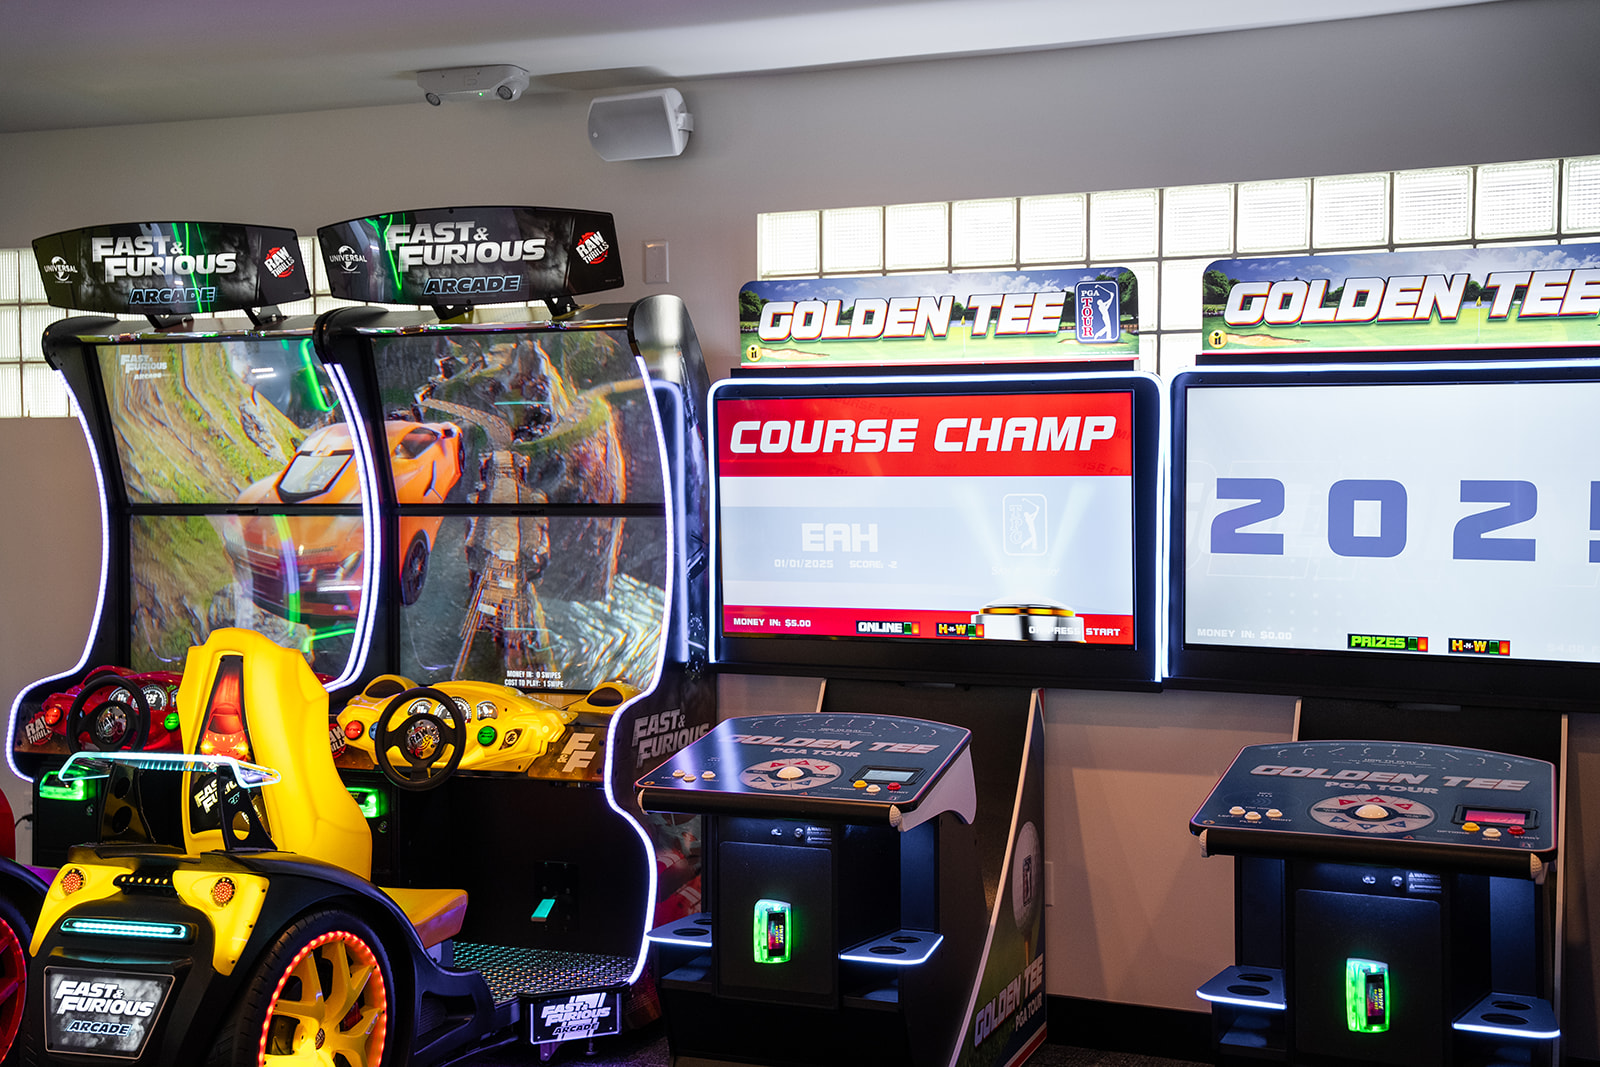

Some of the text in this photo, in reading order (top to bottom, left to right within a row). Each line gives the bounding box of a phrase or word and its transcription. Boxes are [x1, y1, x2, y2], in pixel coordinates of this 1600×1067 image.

[386, 221, 489, 250] FAST &
[576, 231, 604, 258] RAW
[92, 236, 184, 262] FAST &
[264, 246, 290, 272] RAW
[329, 253, 368, 263] UNIVERSAL
[398, 238, 546, 272] FURIOUS
[583, 242, 609, 264] THRILLS
[44, 264, 78, 274] UNIVERSAL
[104, 252, 236, 283] FURIOUS
[271, 256, 294, 277] THRILLS
[423, 275, 522, 295] ARCADE
[129, 287, 216, 304] ARCADE
[1224, 268, 1600, 328] GOLDEN TEE
[758, 291, 1066, 342] GOLDEN TEE
[1081, 297, 1094, 338] TOUR
[125, 362, 167, 374] FURIOUS
[730, 415, 1117, 453] COURSE CHAMP
[801, 523, 878, 552] EAH
[774, 559, 834, 568] 01/01/2025
[733, 618, 811, 628] MONEY IN: $5.00
[858, 622, 902, 633] ONLINE
[1086, 628, 1120, 636] START
[1197, 628, 1292, 640] MONEY IN: $0.00
[1350, 636, 1406, 648] PRIZES
[632, 709, 686, 747] FAST &
[561, 732, 595, 755] F
[719, 734, 940, 754] GOLDEN TEE
[811, 749, 860, 758] TOUR
[1250, 764, 1531, 792] GOLDEN TEE
[1324, 782, 1439, 794] PGA TOUR
[194, 779, 217, 808] FAS
[54, 980, 124, 999] FAST &
[56, 996, 155, 1016] FURIOUS
[540, 1003, 583, 1018] FAST
[975, 953, 1044, 1048] GOLDEN TEE
[545, 1007, 611, 1026] FURIOUS
[1016, 992, 1042, 1032] PGA TOUR
[67, 1020, 132, 1036] ARCADE
[552, 1022, 599, 1035] ARCADE
